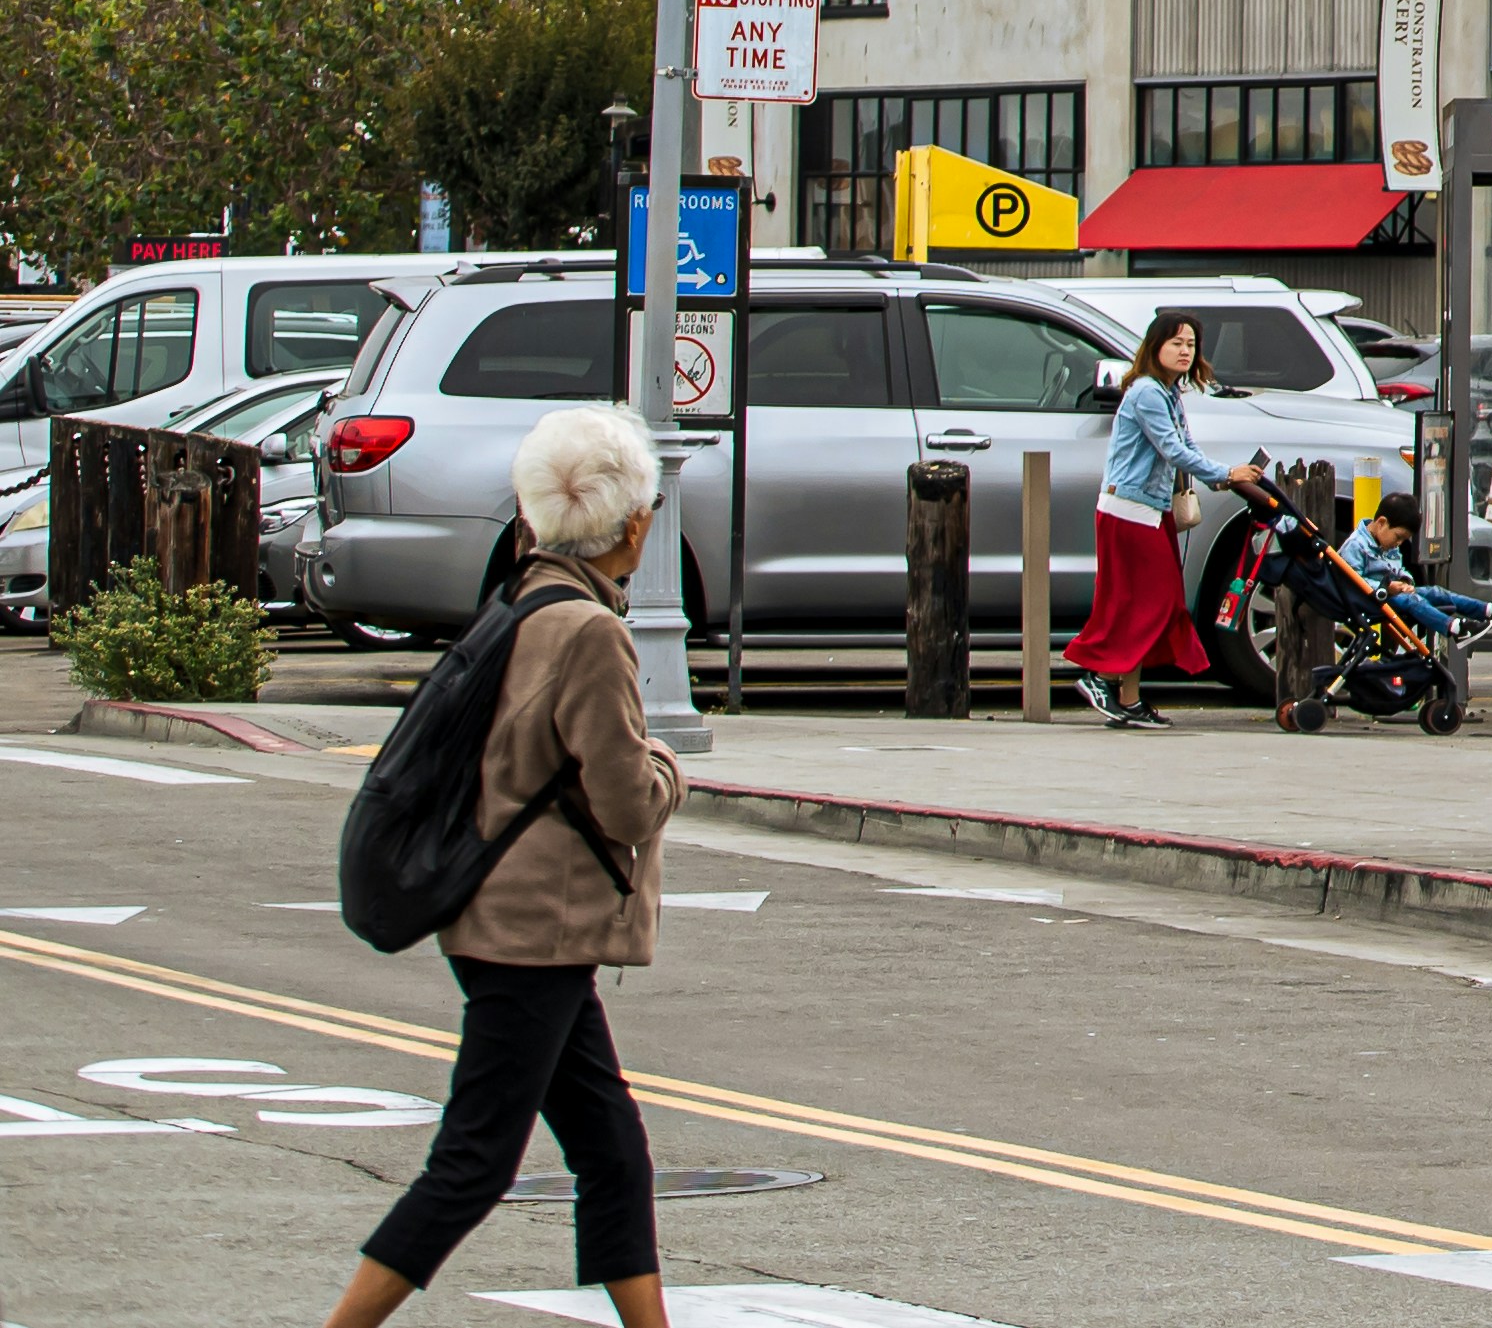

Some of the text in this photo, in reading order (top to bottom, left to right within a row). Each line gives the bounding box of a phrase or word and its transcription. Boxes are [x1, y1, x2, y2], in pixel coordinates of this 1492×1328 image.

[730, 20, 783, 43] ANY
[726, 46, 786, 70] TIME
[131, 242, 222, 261] PAY HERE
[684, 313, 697, 324] DO
[700, 313, 718, 324] NOT
[674, 324, 715, 335] PIGEONS
